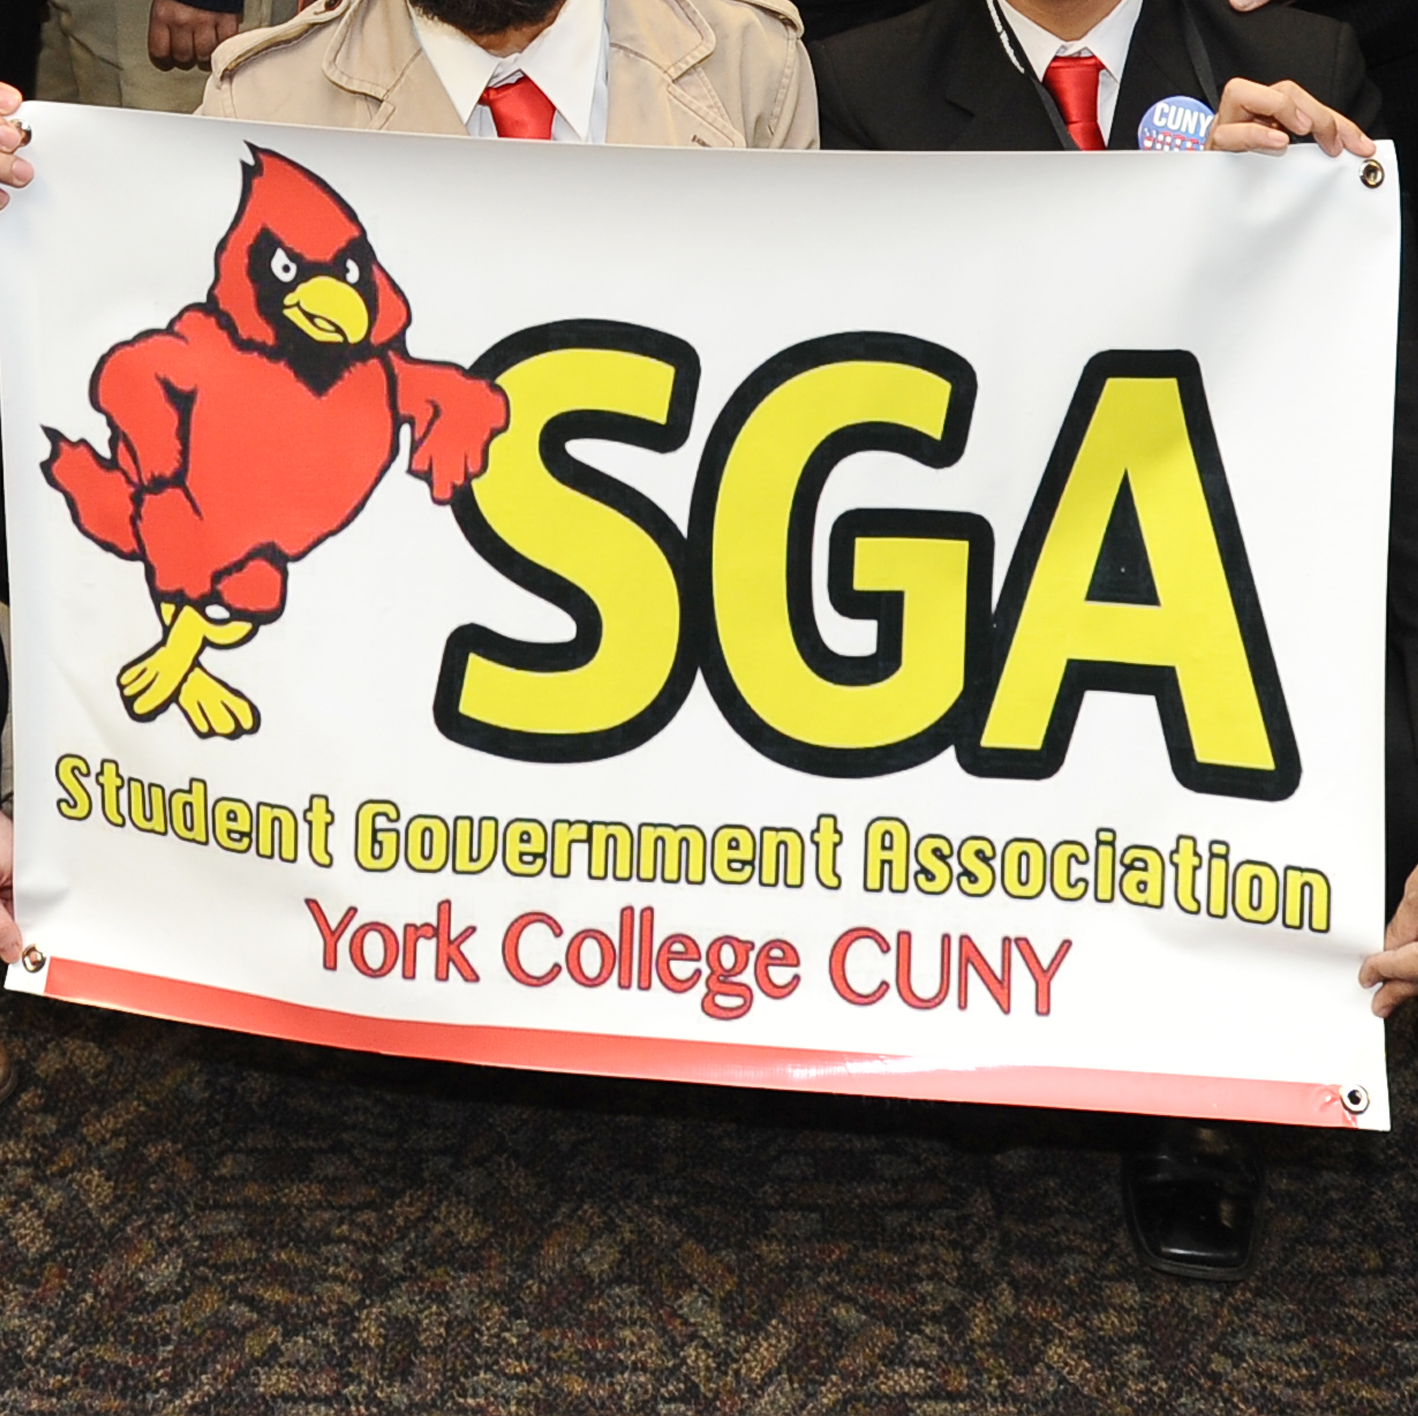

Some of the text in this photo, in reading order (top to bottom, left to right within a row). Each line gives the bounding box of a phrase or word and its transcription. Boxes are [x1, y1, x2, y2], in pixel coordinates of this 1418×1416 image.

[1153, 102, 1214, 137] CUNY
[433, 318, 1302, 802] SGA
[56, 755, 1332, 933] Student Government Association
[304, 898, 1073, 1021] York College CUNY
